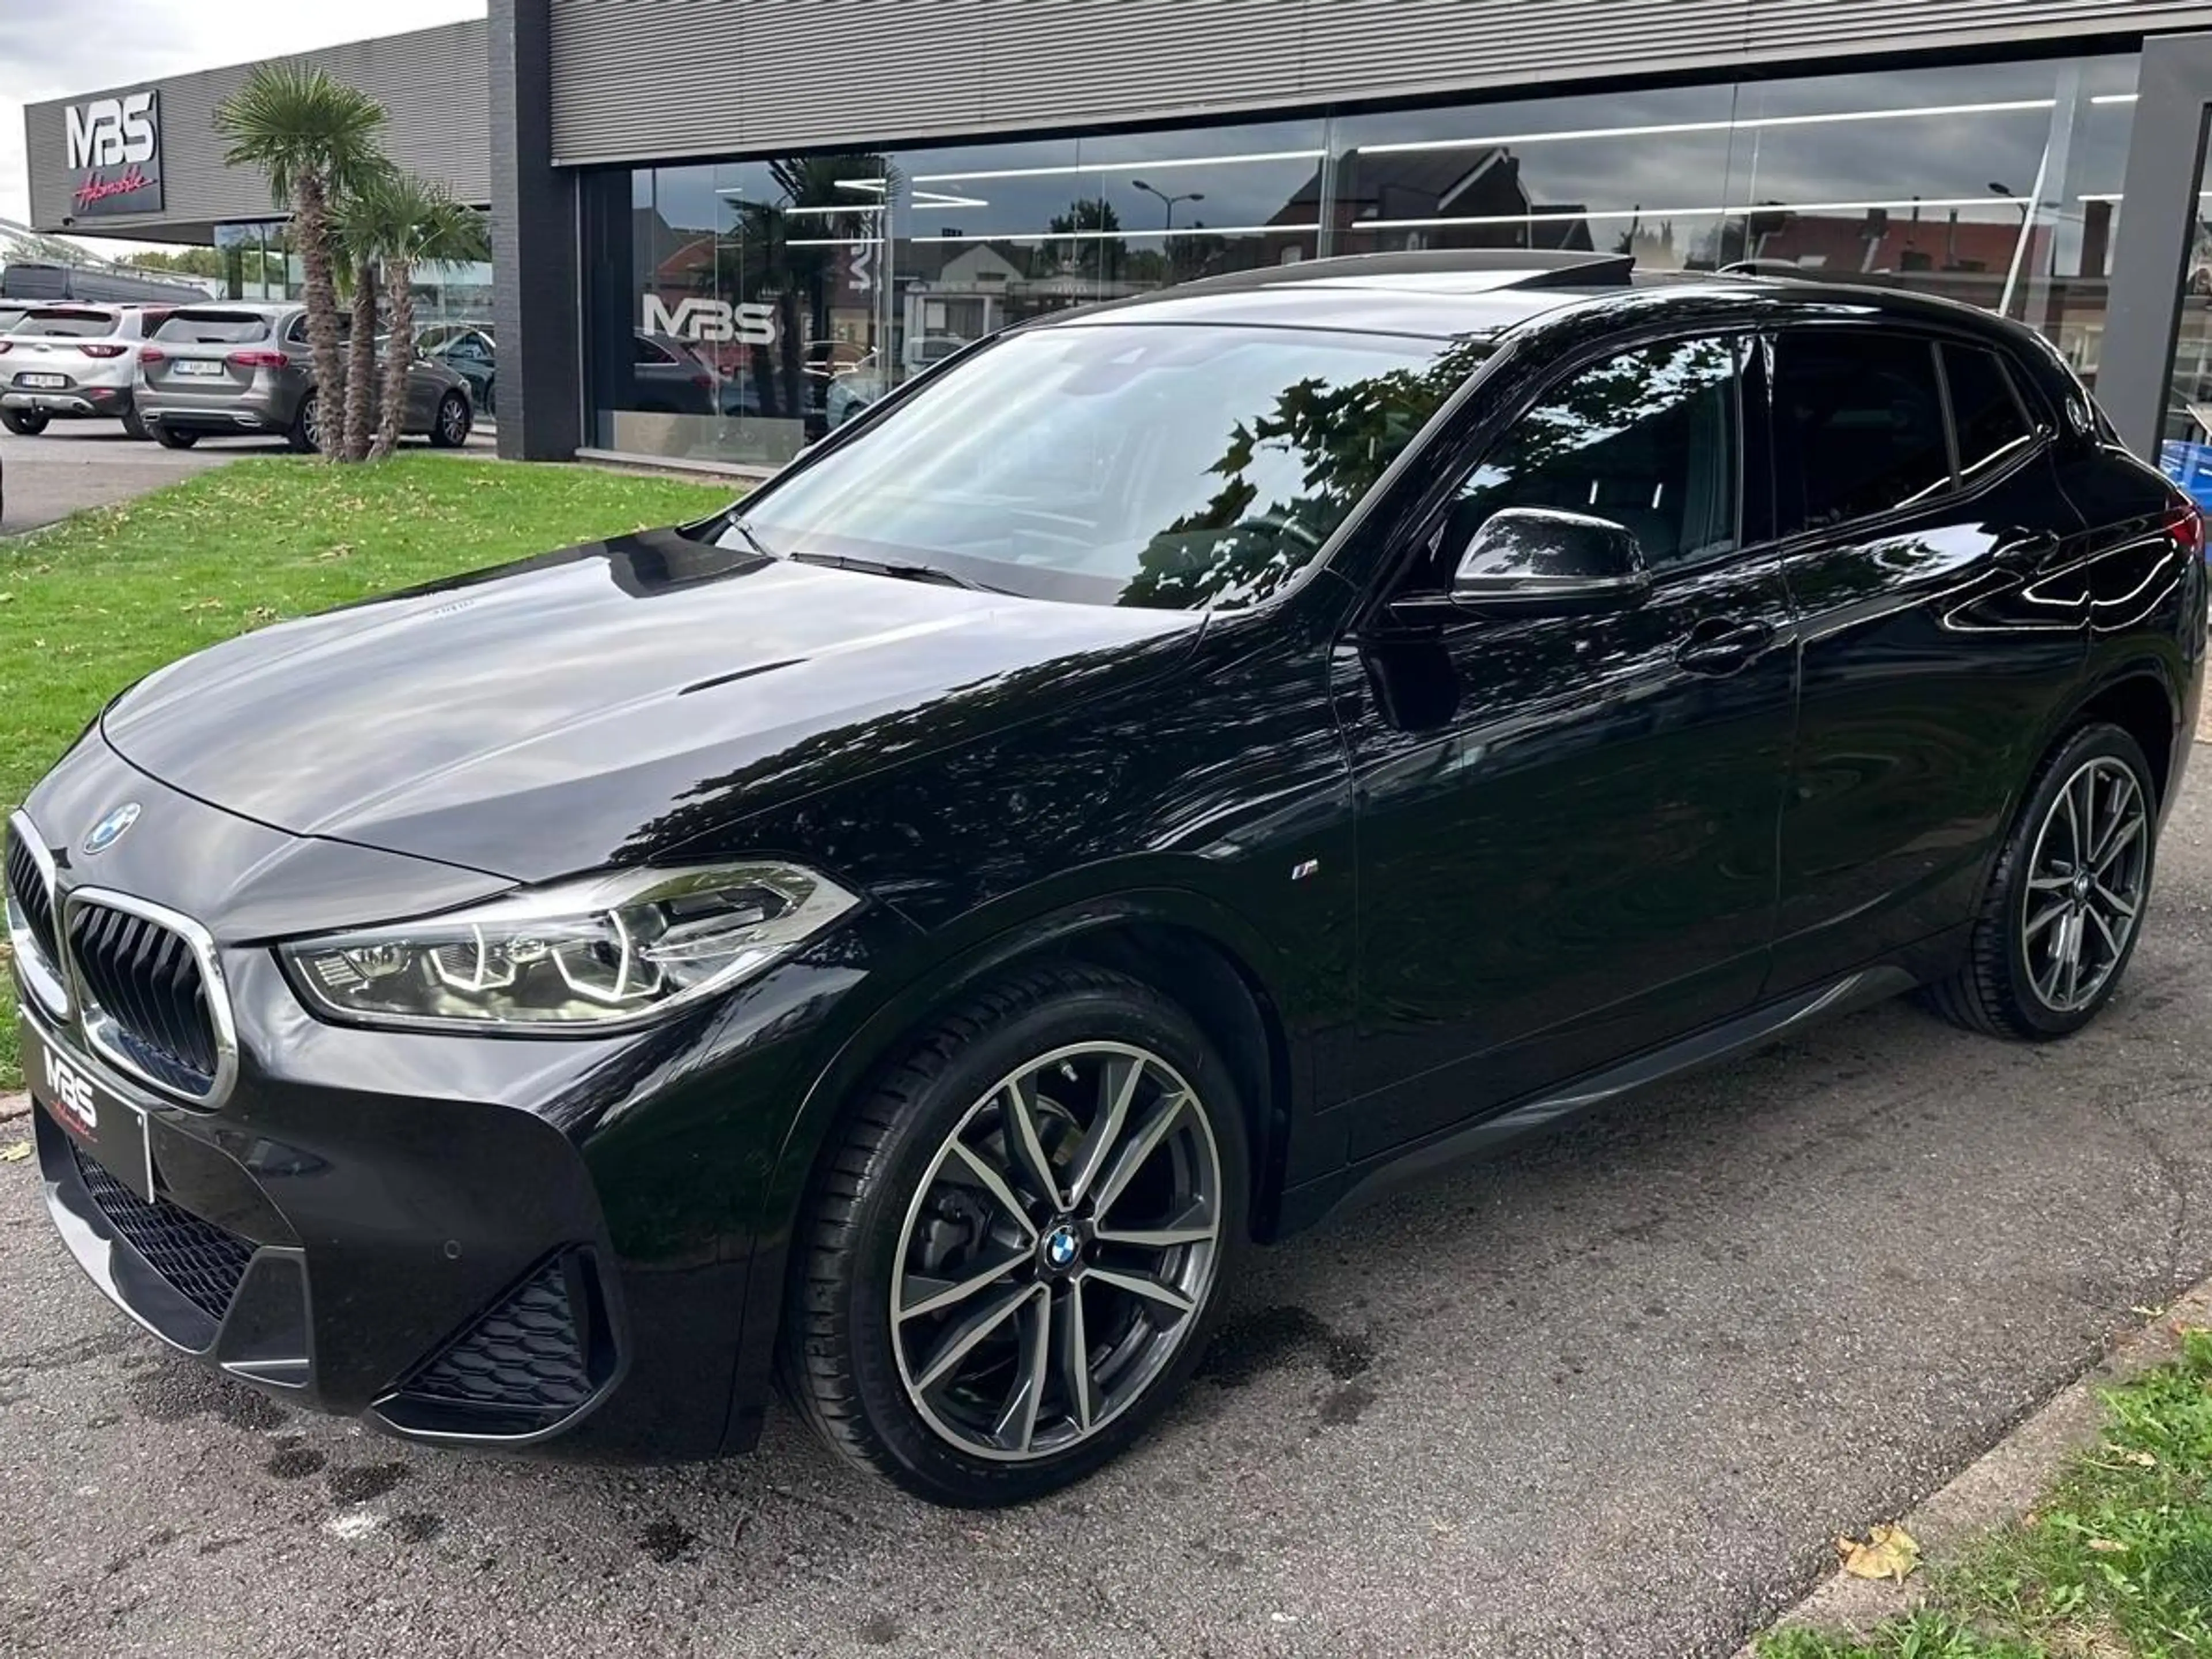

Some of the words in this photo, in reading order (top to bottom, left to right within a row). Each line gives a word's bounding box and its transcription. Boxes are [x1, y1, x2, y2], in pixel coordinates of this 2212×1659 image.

[66, 92, 154, 169] MBS
[643, 294, 776, 344] MBS
[43, 1045, 97, 1127] MBS
